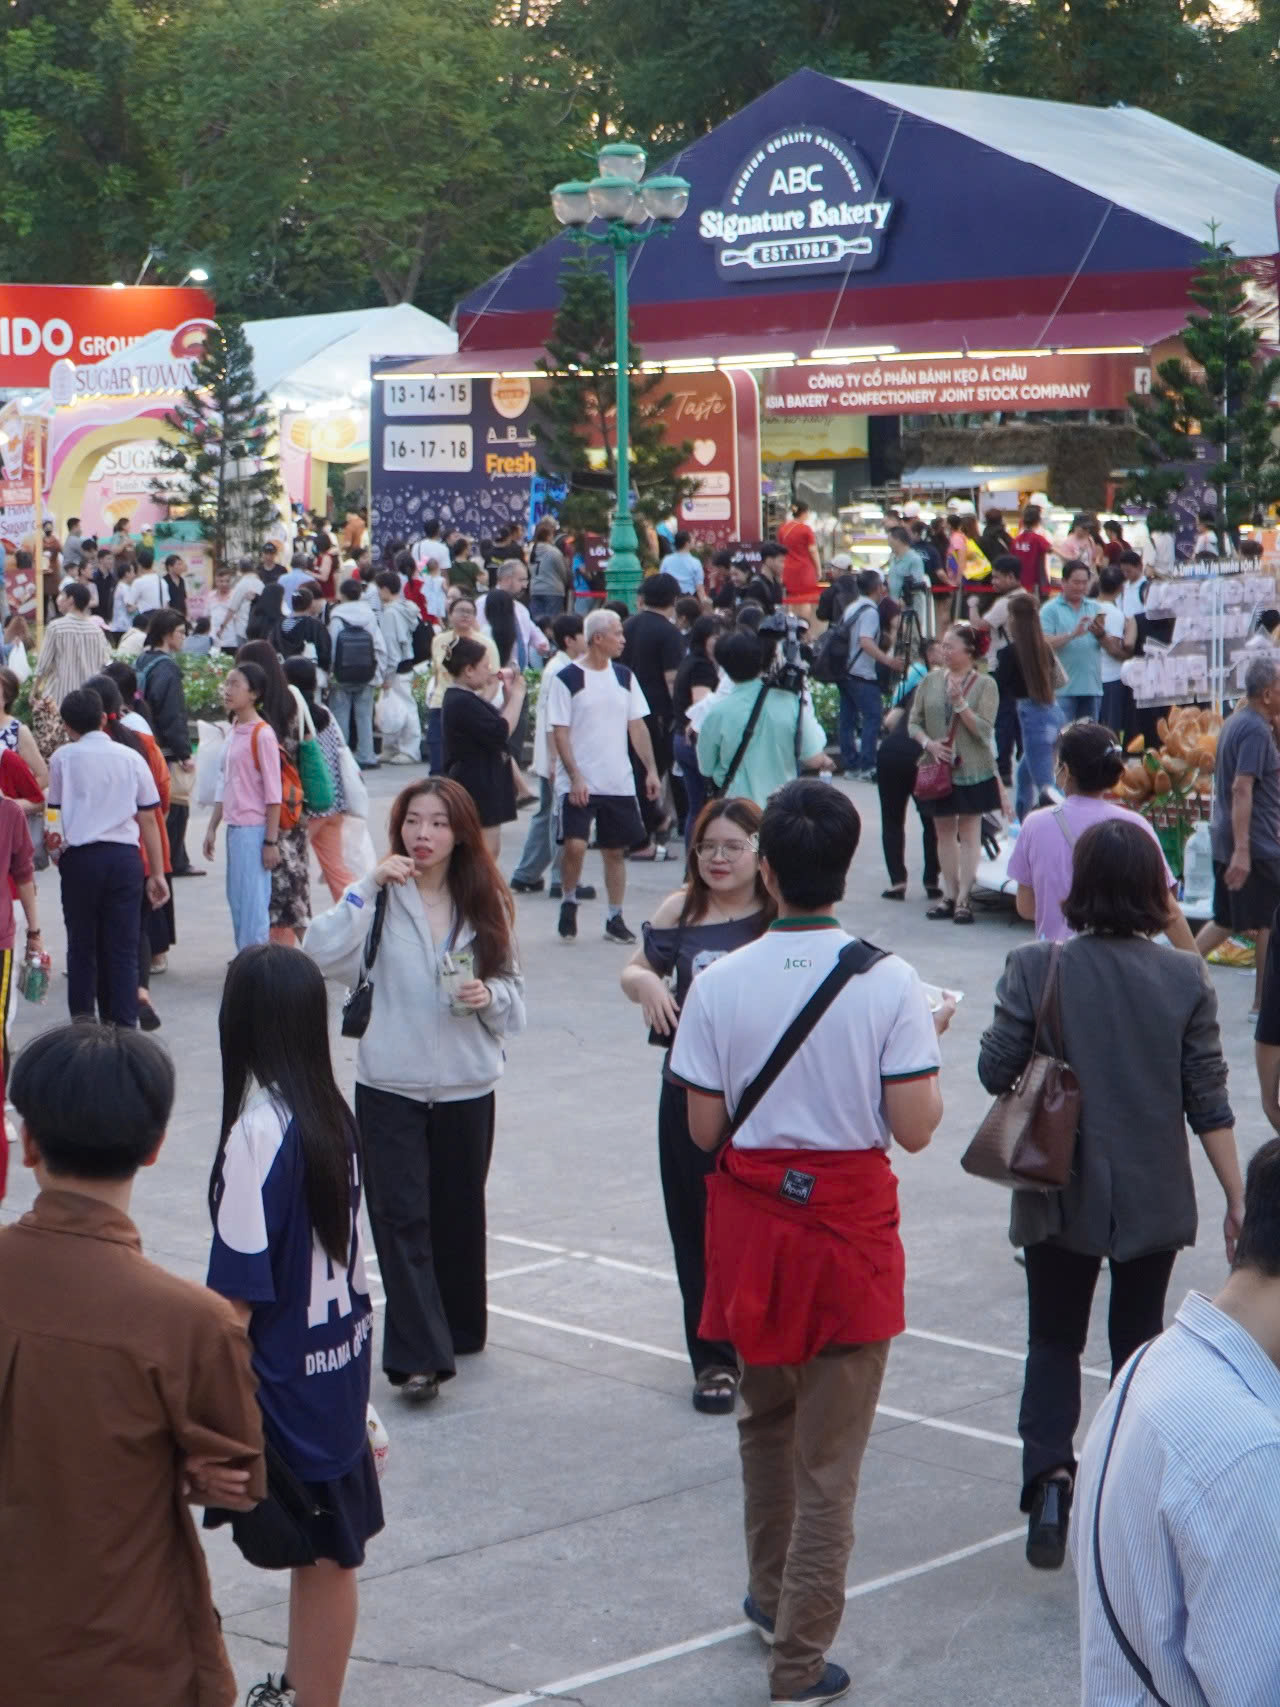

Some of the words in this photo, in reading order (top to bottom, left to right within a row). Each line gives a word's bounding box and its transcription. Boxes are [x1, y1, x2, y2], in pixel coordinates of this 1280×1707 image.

[767, 132, 813, 153] QUALITY
[768, 164, 824, 197] ABC
[699, 209, 805, 243] Signature
[809, 199, 891, 230] Bakery
[75, 370, 132, 392] SUGAR
[136, 363, 198, 388] TOWN
[807, 374, 844, 390] CÔNG
[846, 373, 861, 388] TY
[918, 366, 952, 384] BÁNH
[391, 385, 407, 404] 13
[420, 385, 436, 402] 14
[450, 384, 467, 402] 15
[674, 390, 726, 422] Taste
[786, 393, 829, 408] BAKERY
[840, 388, 937, 407] CONFECTIONERY
[939, 387, 975, 403] JOINT
[976, 385, 1019, 402] STOCK
[1020, 383, 1092, 400] COMPANY
[391, 441, 407, 459] 16
[420, 441, 437, 459] 17
[451, 441, 467, 458] 18
[485, 451, 537, 475] Fresh
[305, 1341, 352, 1377] DRAMA
